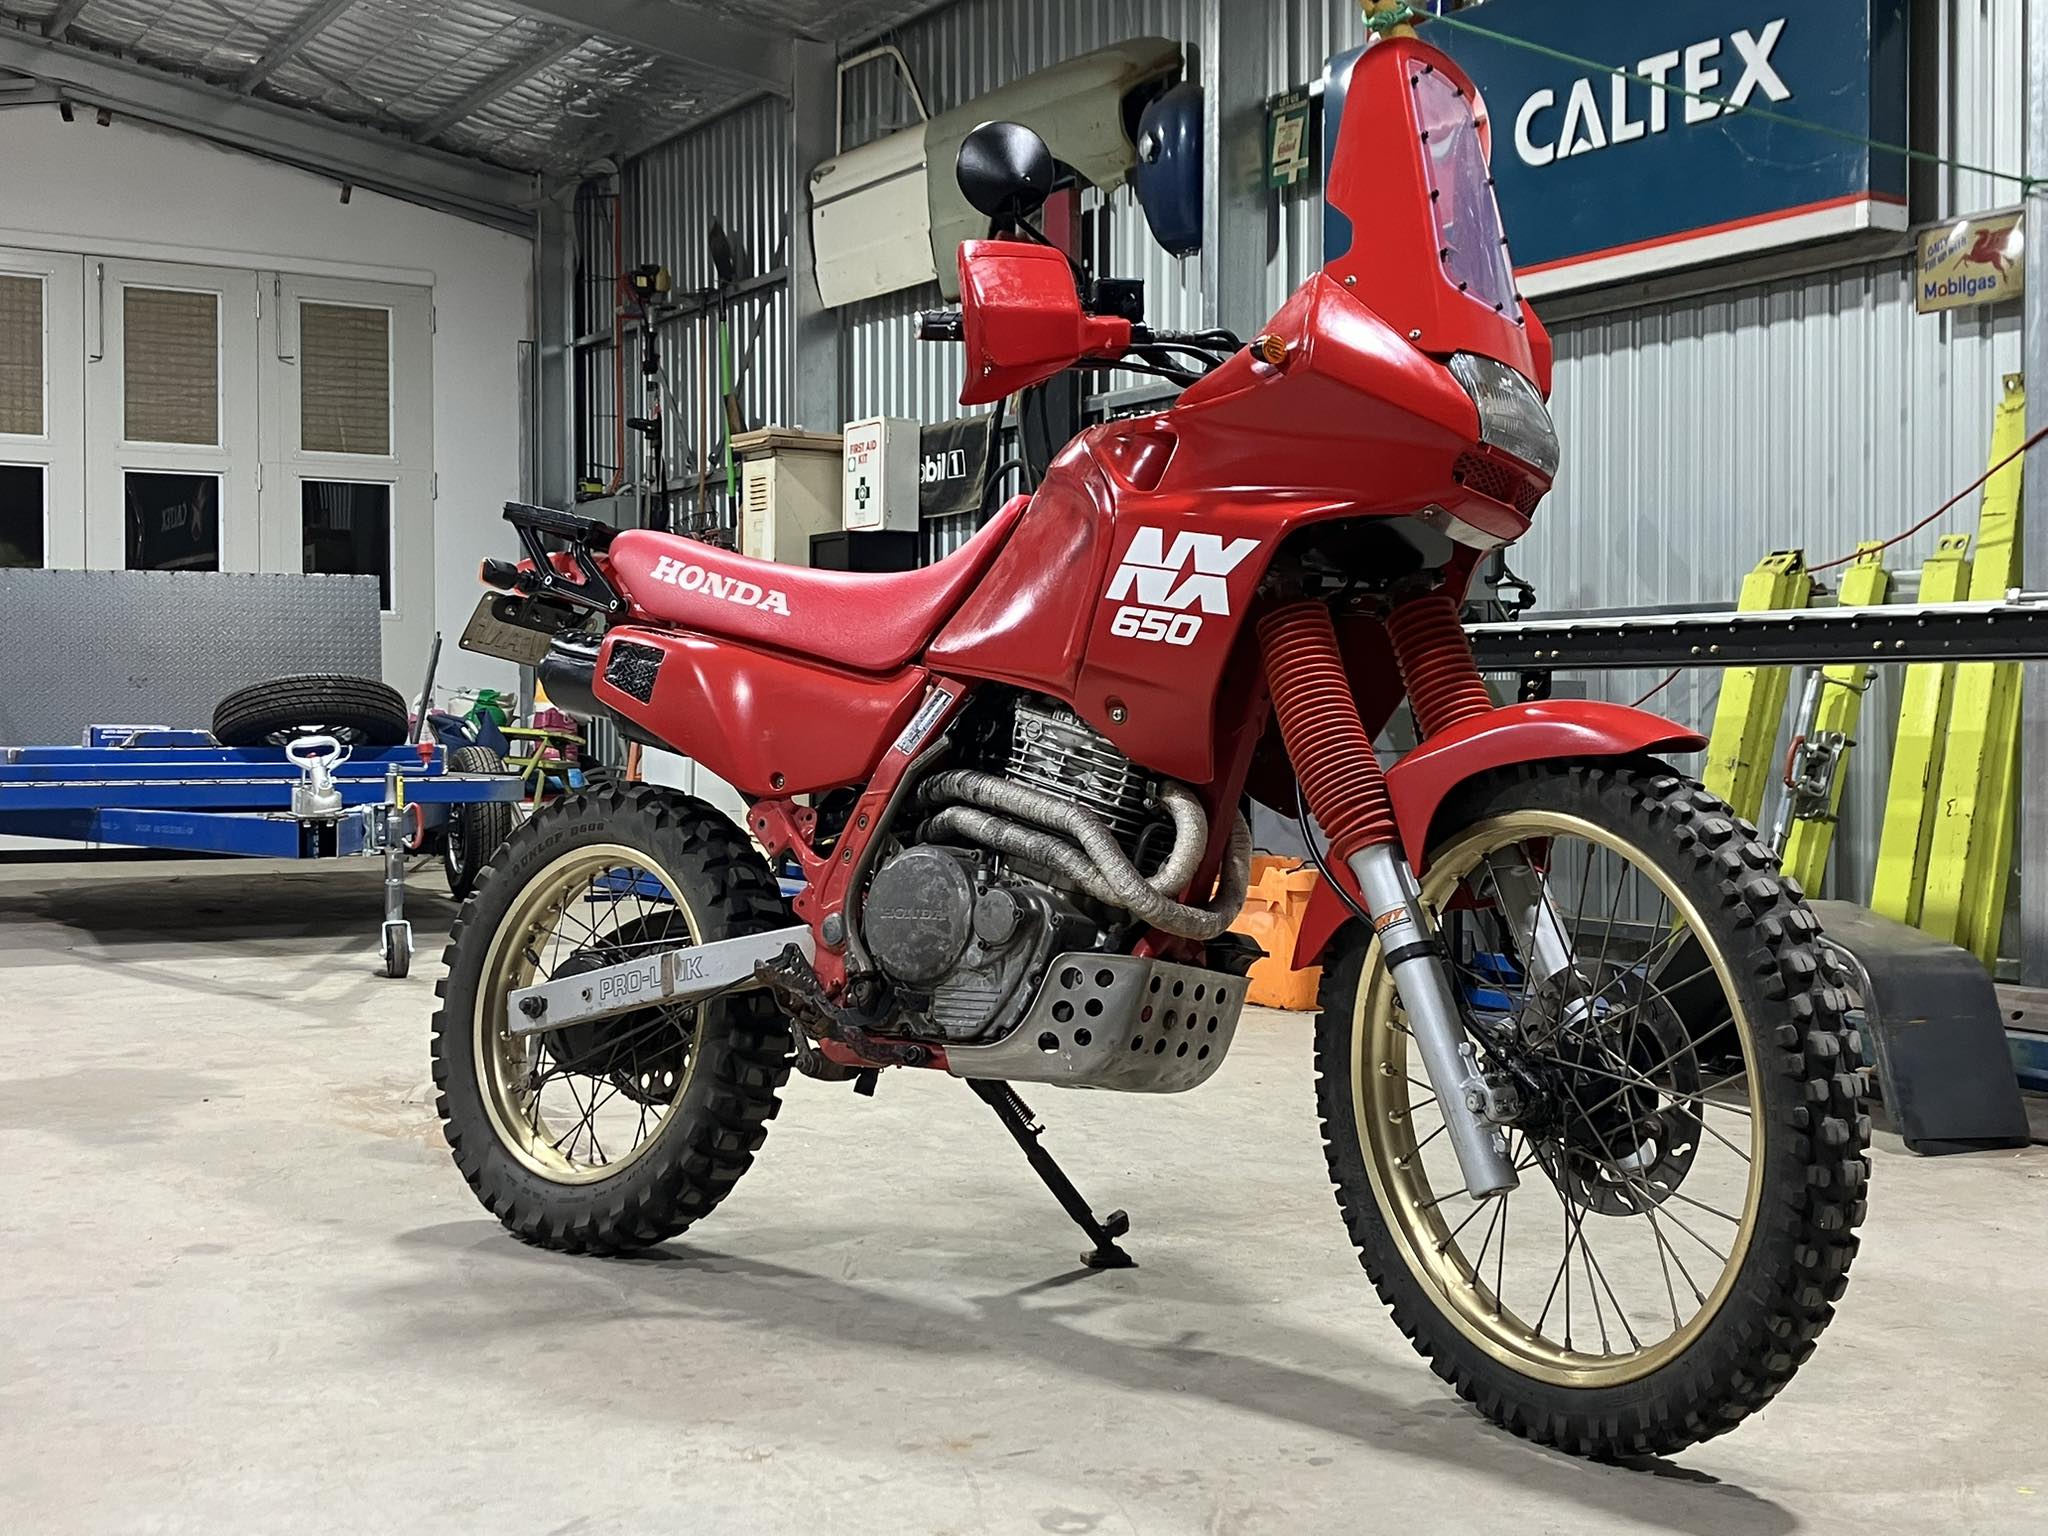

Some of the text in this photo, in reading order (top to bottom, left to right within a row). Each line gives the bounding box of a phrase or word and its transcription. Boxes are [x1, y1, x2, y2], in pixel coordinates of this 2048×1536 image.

[1514, 17, 1792, 167] CALTEX
[1924, 274, 1997, 299] Mobilgas
[849, 440, 877, 455] FIRST AID
[858, 453, 868, 464] KIT
[920, 452, 947, 483] bil
[650, 555, 791, 616] HONDA
[1110, 605, 1203, 646] 650
[880, 906, 947, 920] HONDA
[600, 956, 703, 1000] PRO-LK
